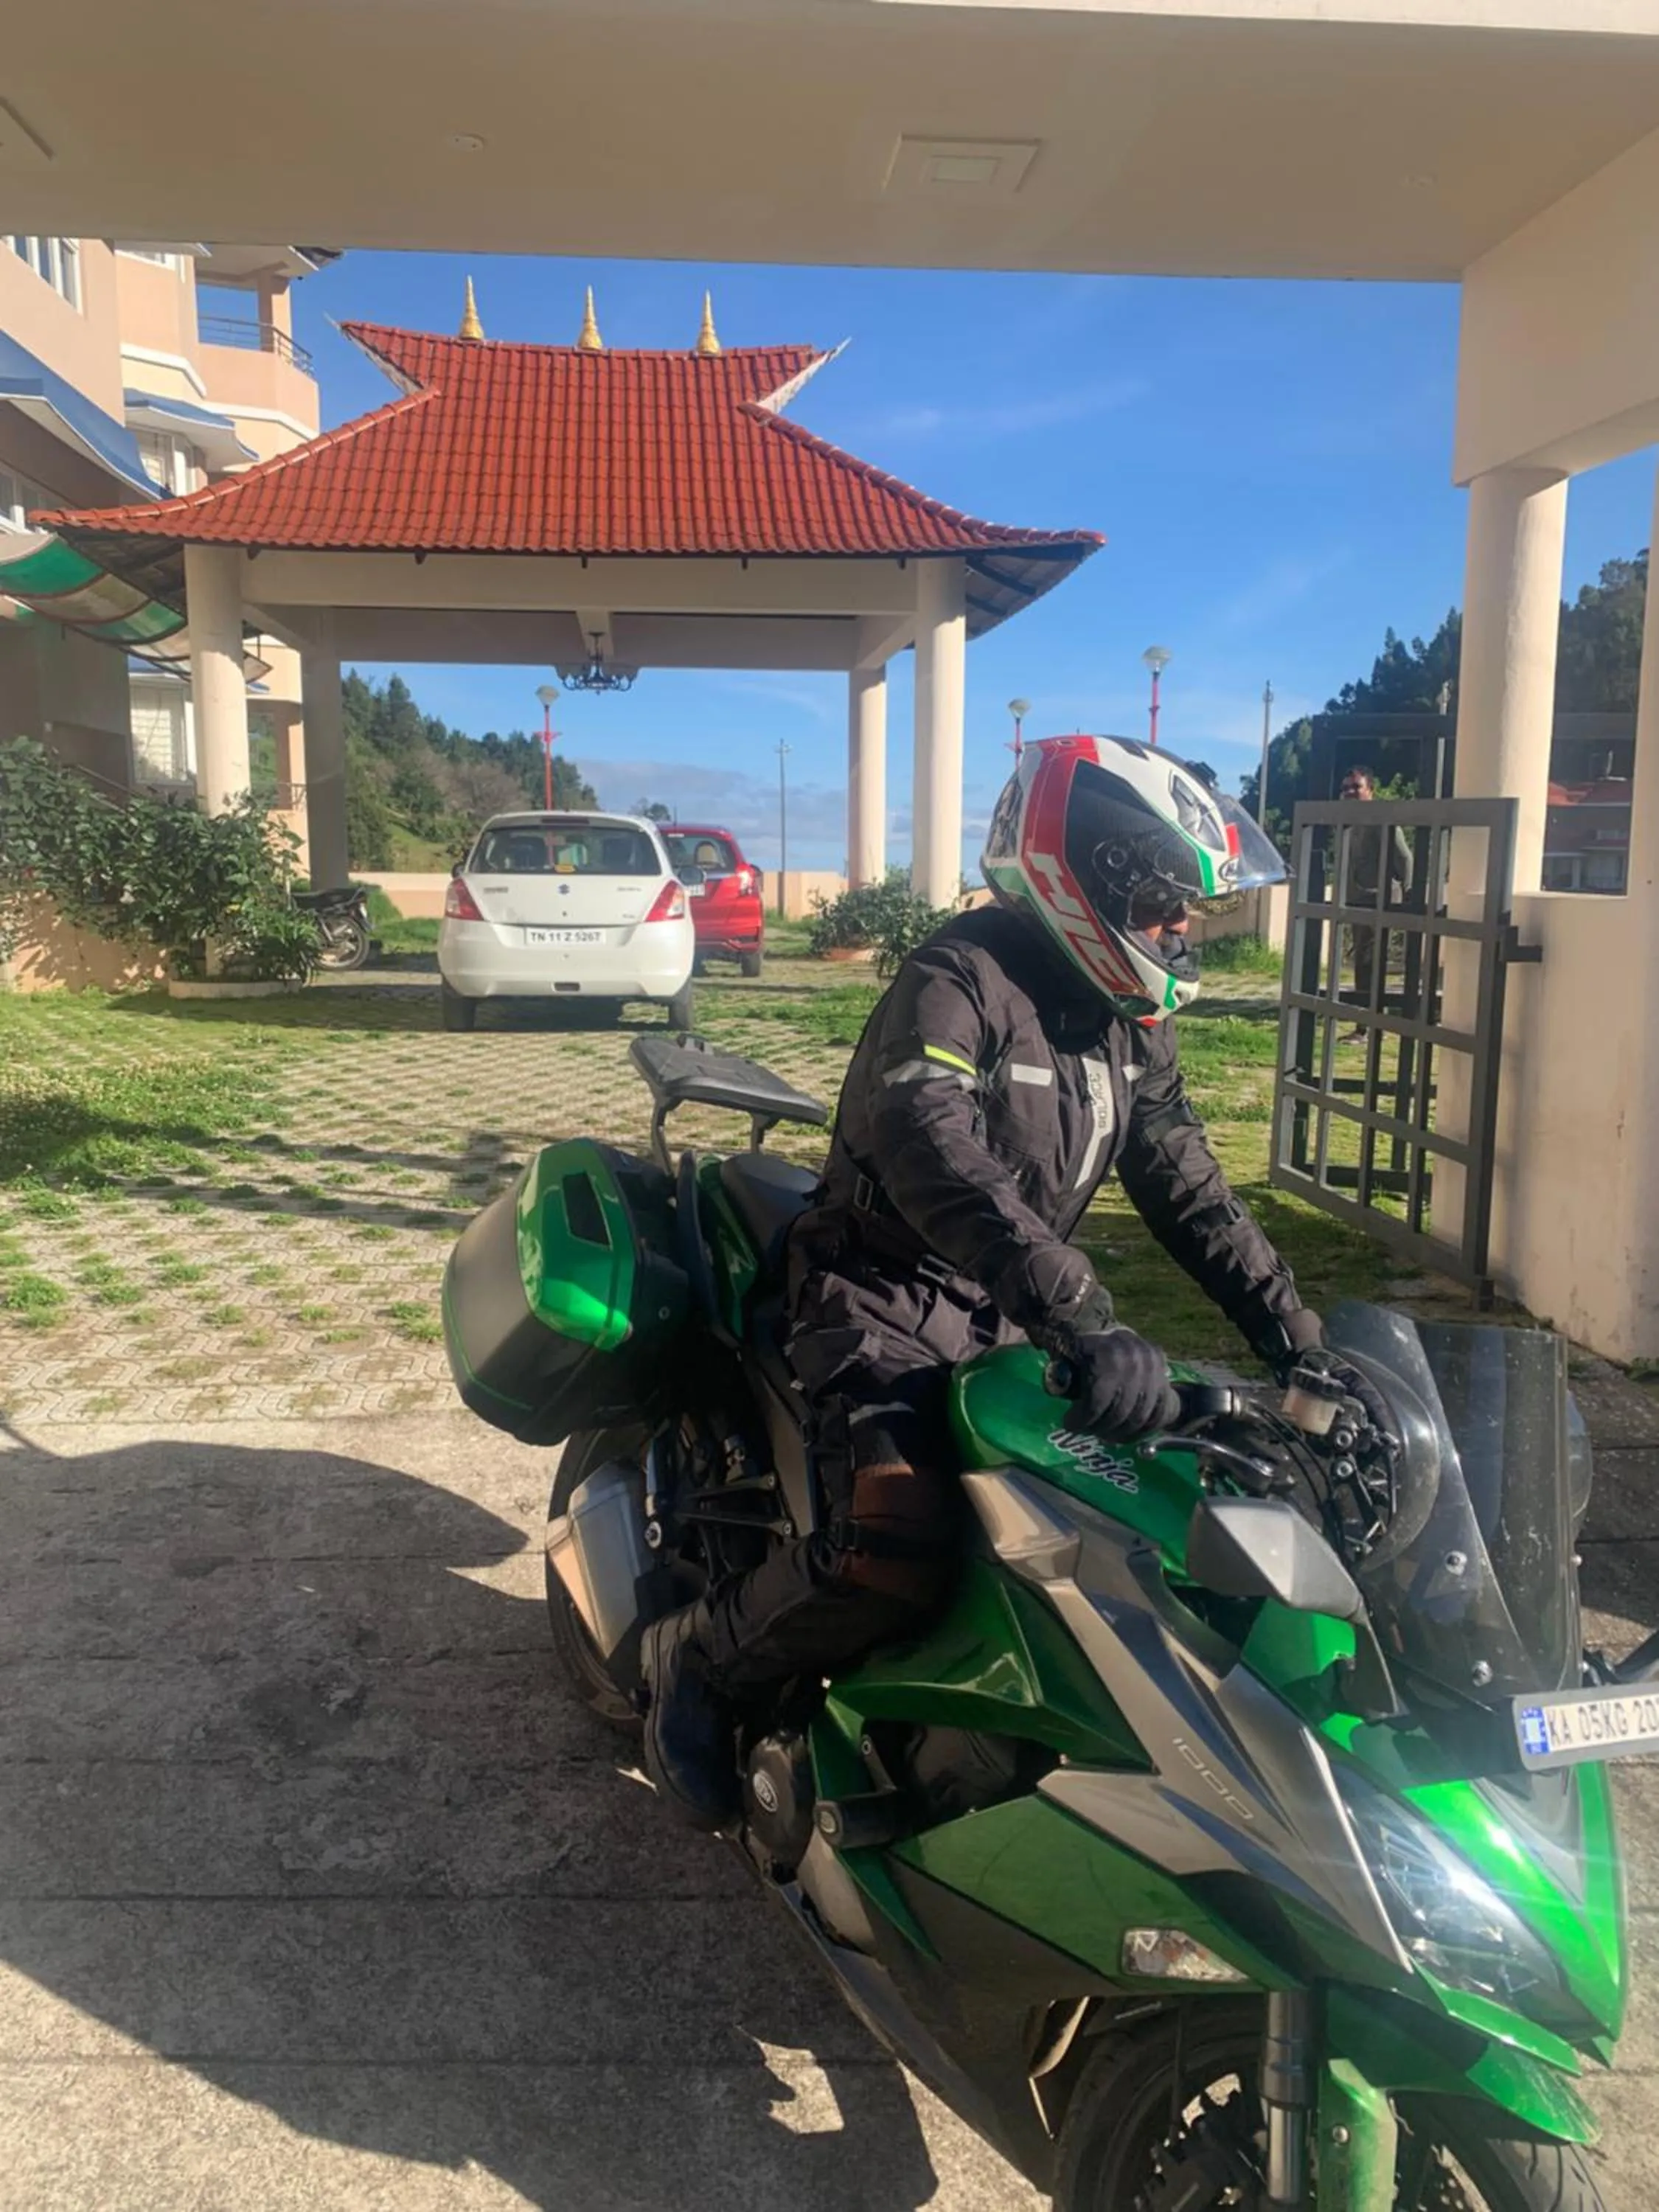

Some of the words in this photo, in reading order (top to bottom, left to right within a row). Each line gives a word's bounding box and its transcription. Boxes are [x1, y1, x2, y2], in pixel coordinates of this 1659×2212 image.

[531, 931, 545, 942] TN
[549, 932, 561, 942] 11
[1047, 1428, 1140, 1495] Ninja
[1548, 1708, 1573, 1746] KA
[1632, 1697, 1659, 1735] 20
[1172, 1738, 1253, 1819] 1000
